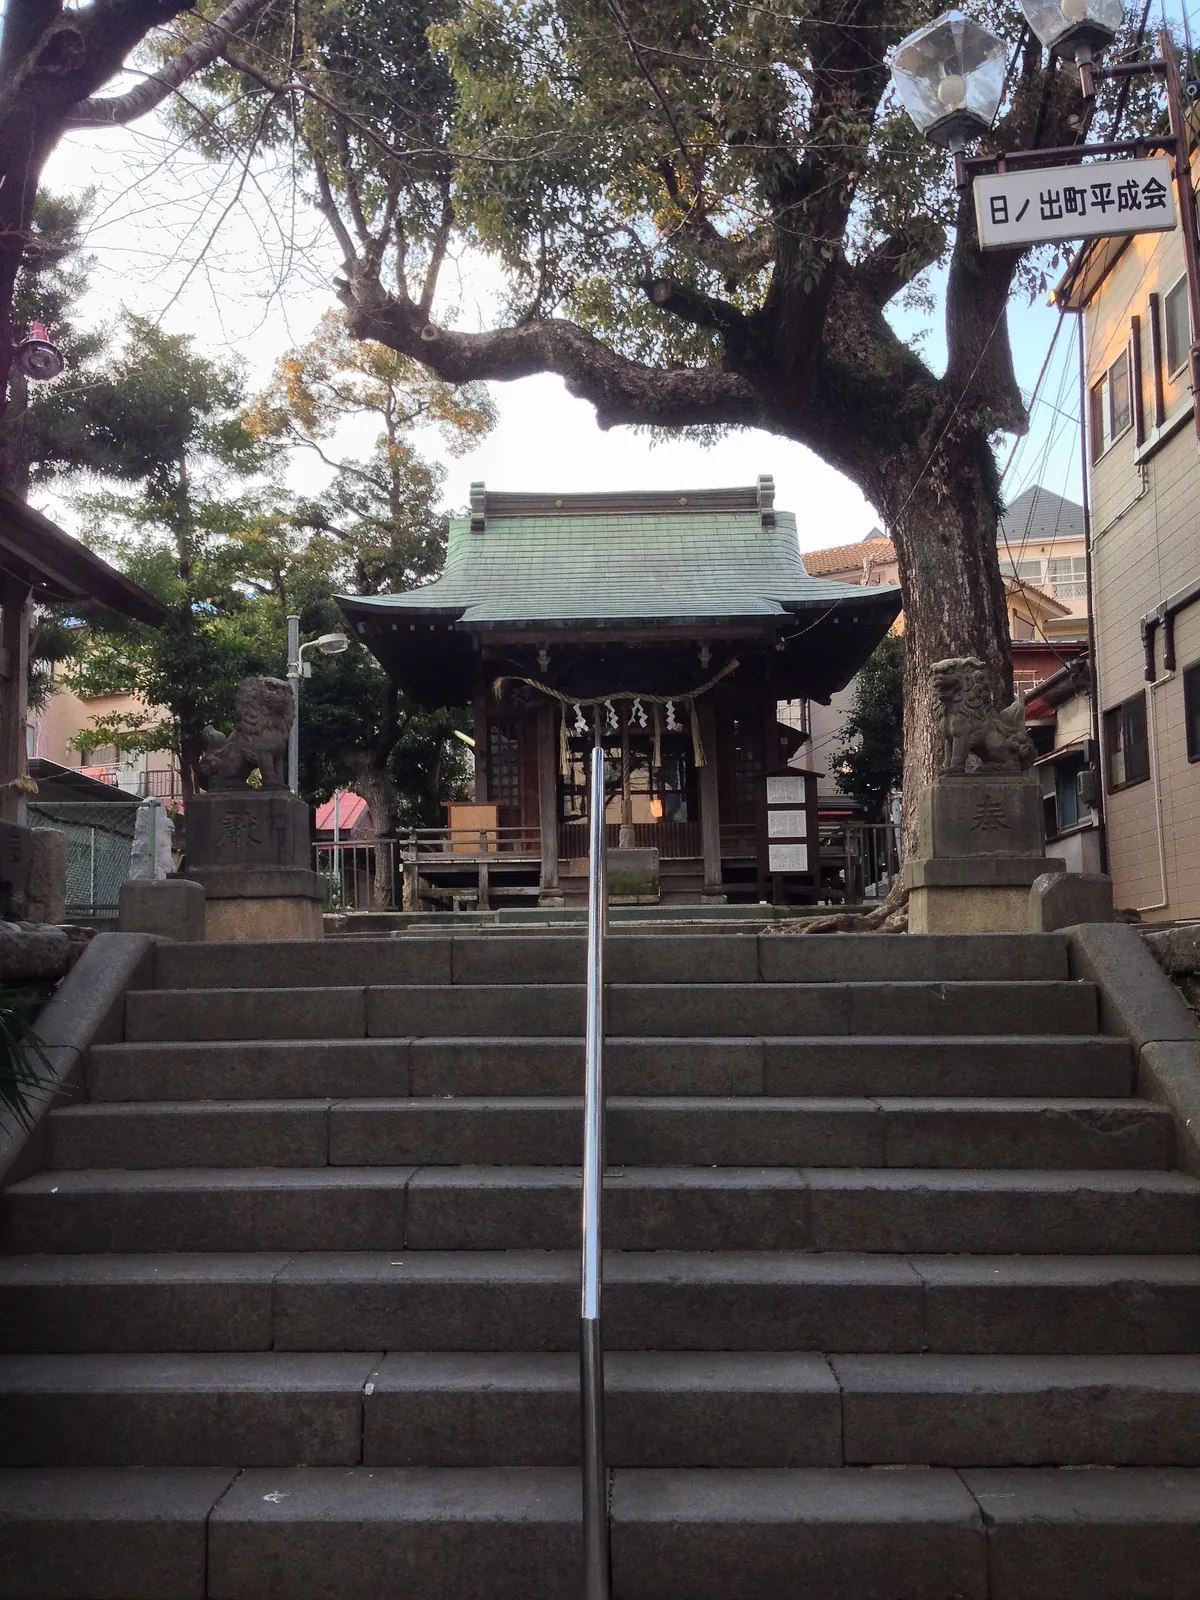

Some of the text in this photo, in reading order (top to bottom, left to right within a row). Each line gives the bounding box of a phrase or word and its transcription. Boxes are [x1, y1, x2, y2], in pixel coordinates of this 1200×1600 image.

[989, 176, 1167, 225] 日ノ出町平成会
[969, 794, 1012, 835] 奉
